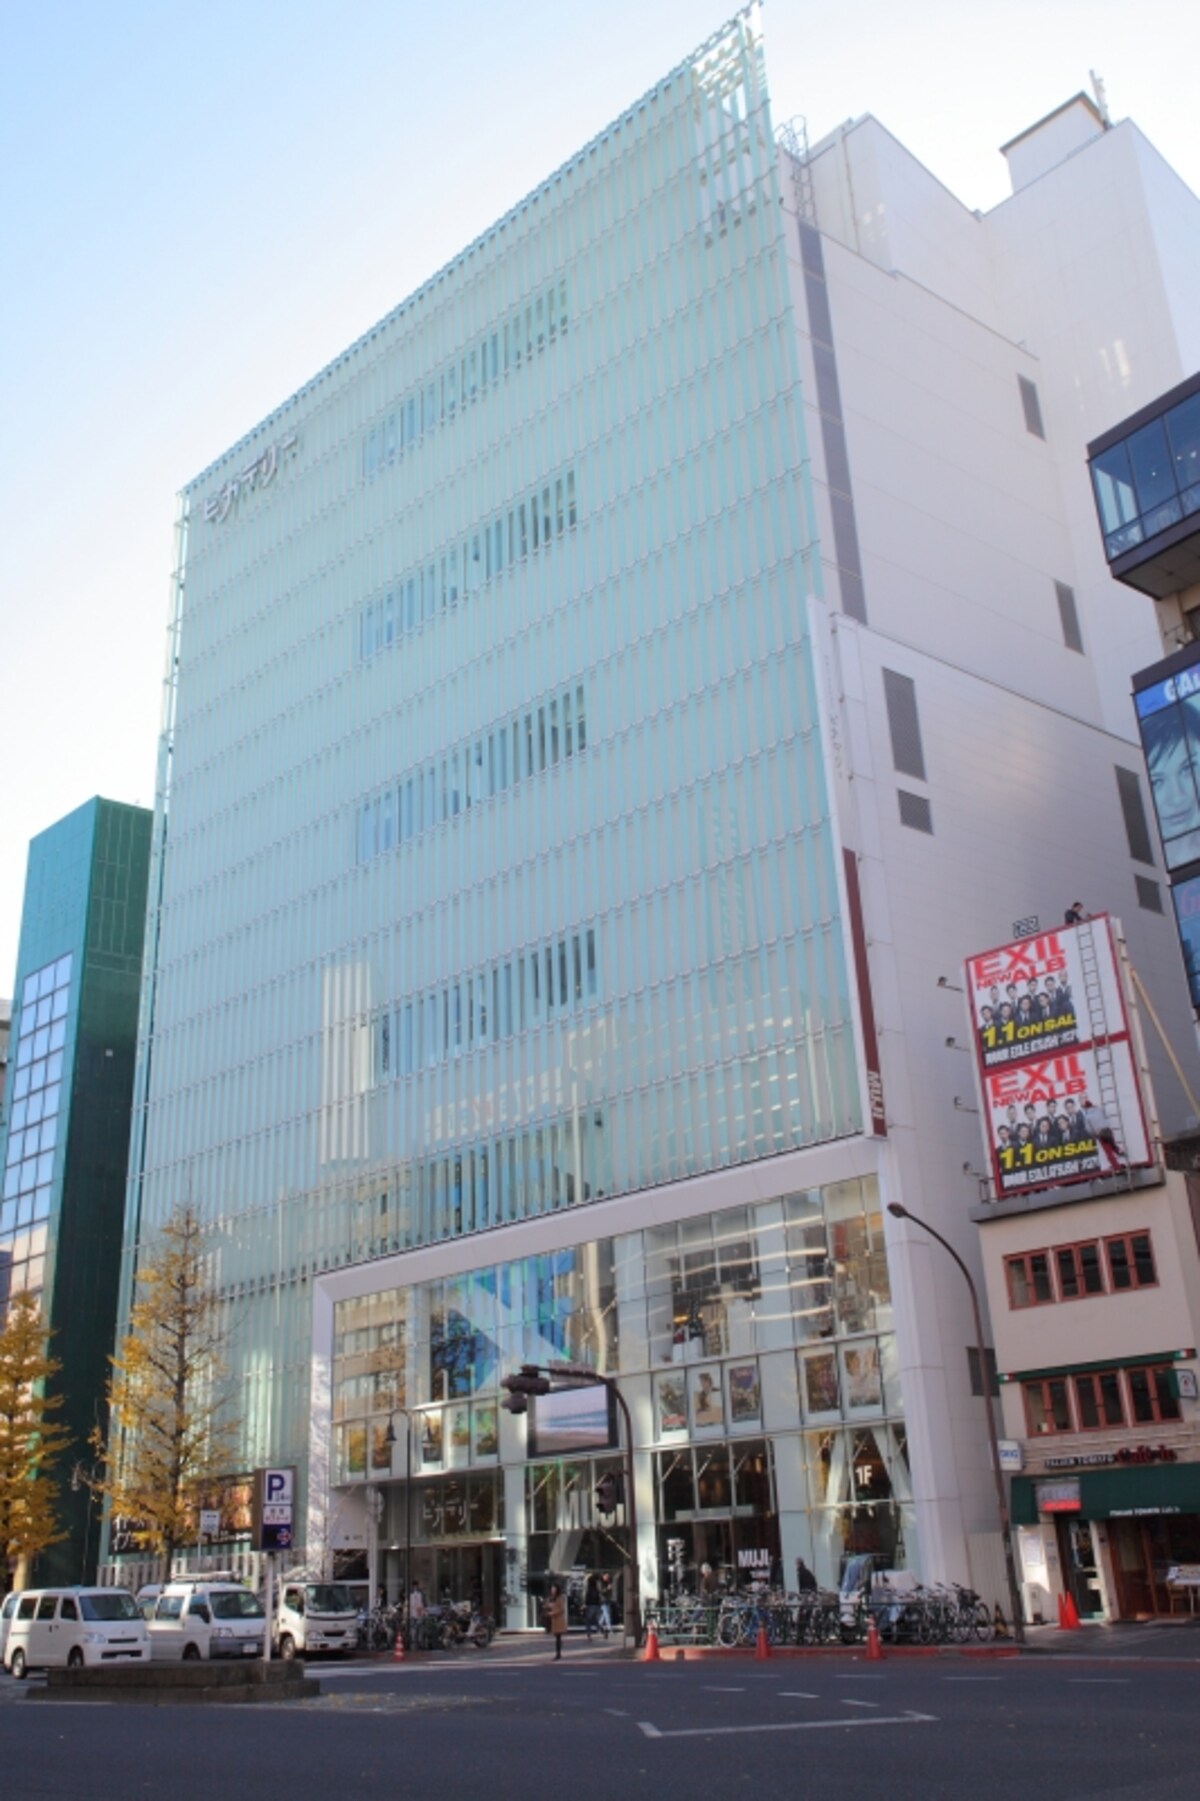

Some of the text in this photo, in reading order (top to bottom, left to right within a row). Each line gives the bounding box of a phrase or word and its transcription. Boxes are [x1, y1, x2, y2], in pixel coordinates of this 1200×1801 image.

[983, 1020, 1015, 1048] 1.1
[1000, 1143, 1034, 1170] 1.1
[267, 1474, 285, 1501] P
[855, 1464, 873, 1486] 1F
